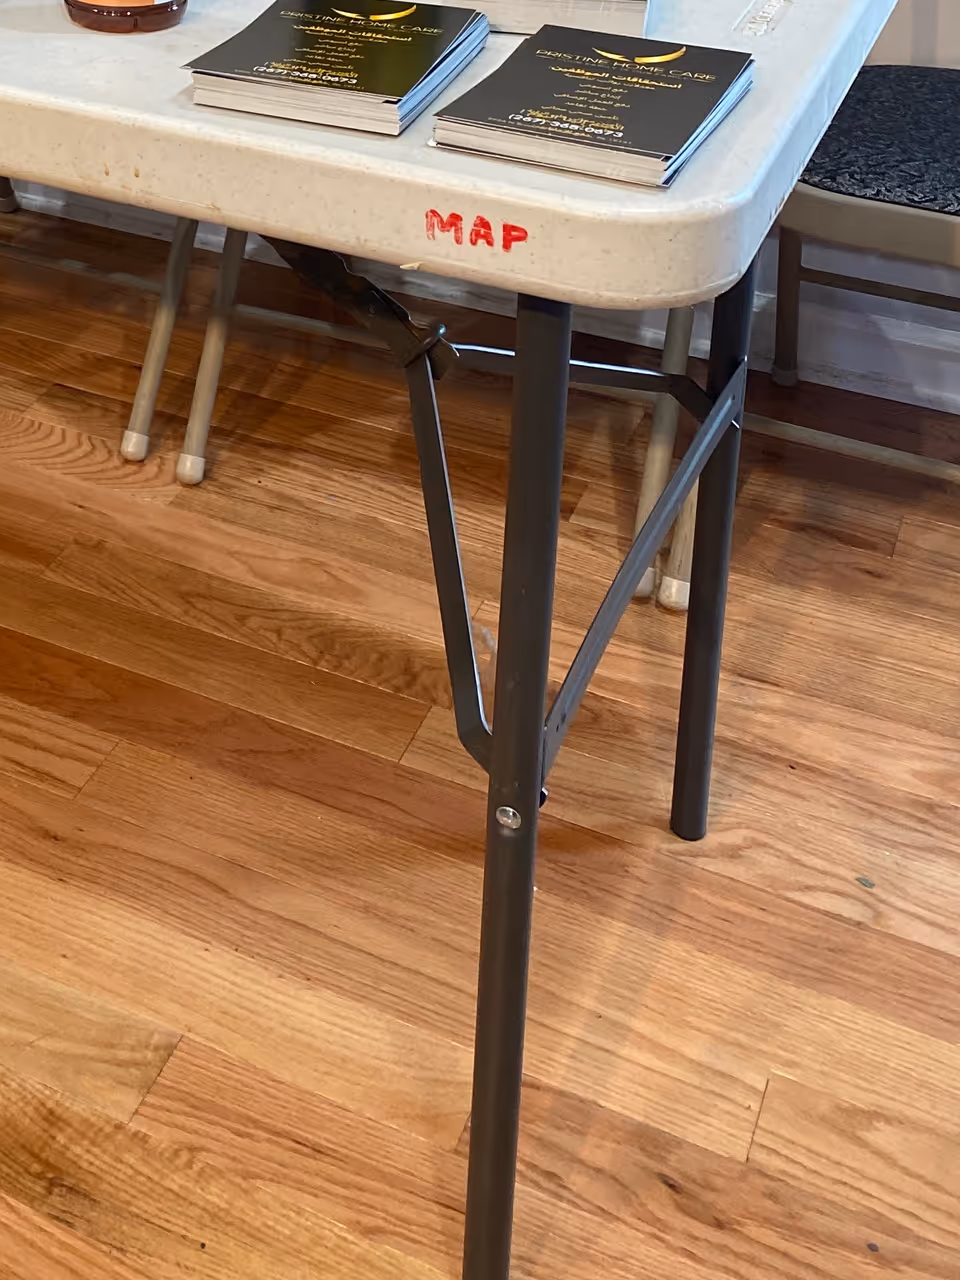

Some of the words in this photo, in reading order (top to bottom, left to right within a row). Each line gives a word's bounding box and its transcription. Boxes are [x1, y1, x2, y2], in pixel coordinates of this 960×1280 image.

[280, 10, 346, 22] PRISTINE
[350, 19, 397, 29] HOME
[400, 24, 445, 34] CARE
[536, 49, 609, 64] PRISTINE
[613, 61, 665, 72] HOME
[669, 69, 718, 80] CARE
[508, 114, 546, 125] (267)
[425, 209, 528, 253] MAP
